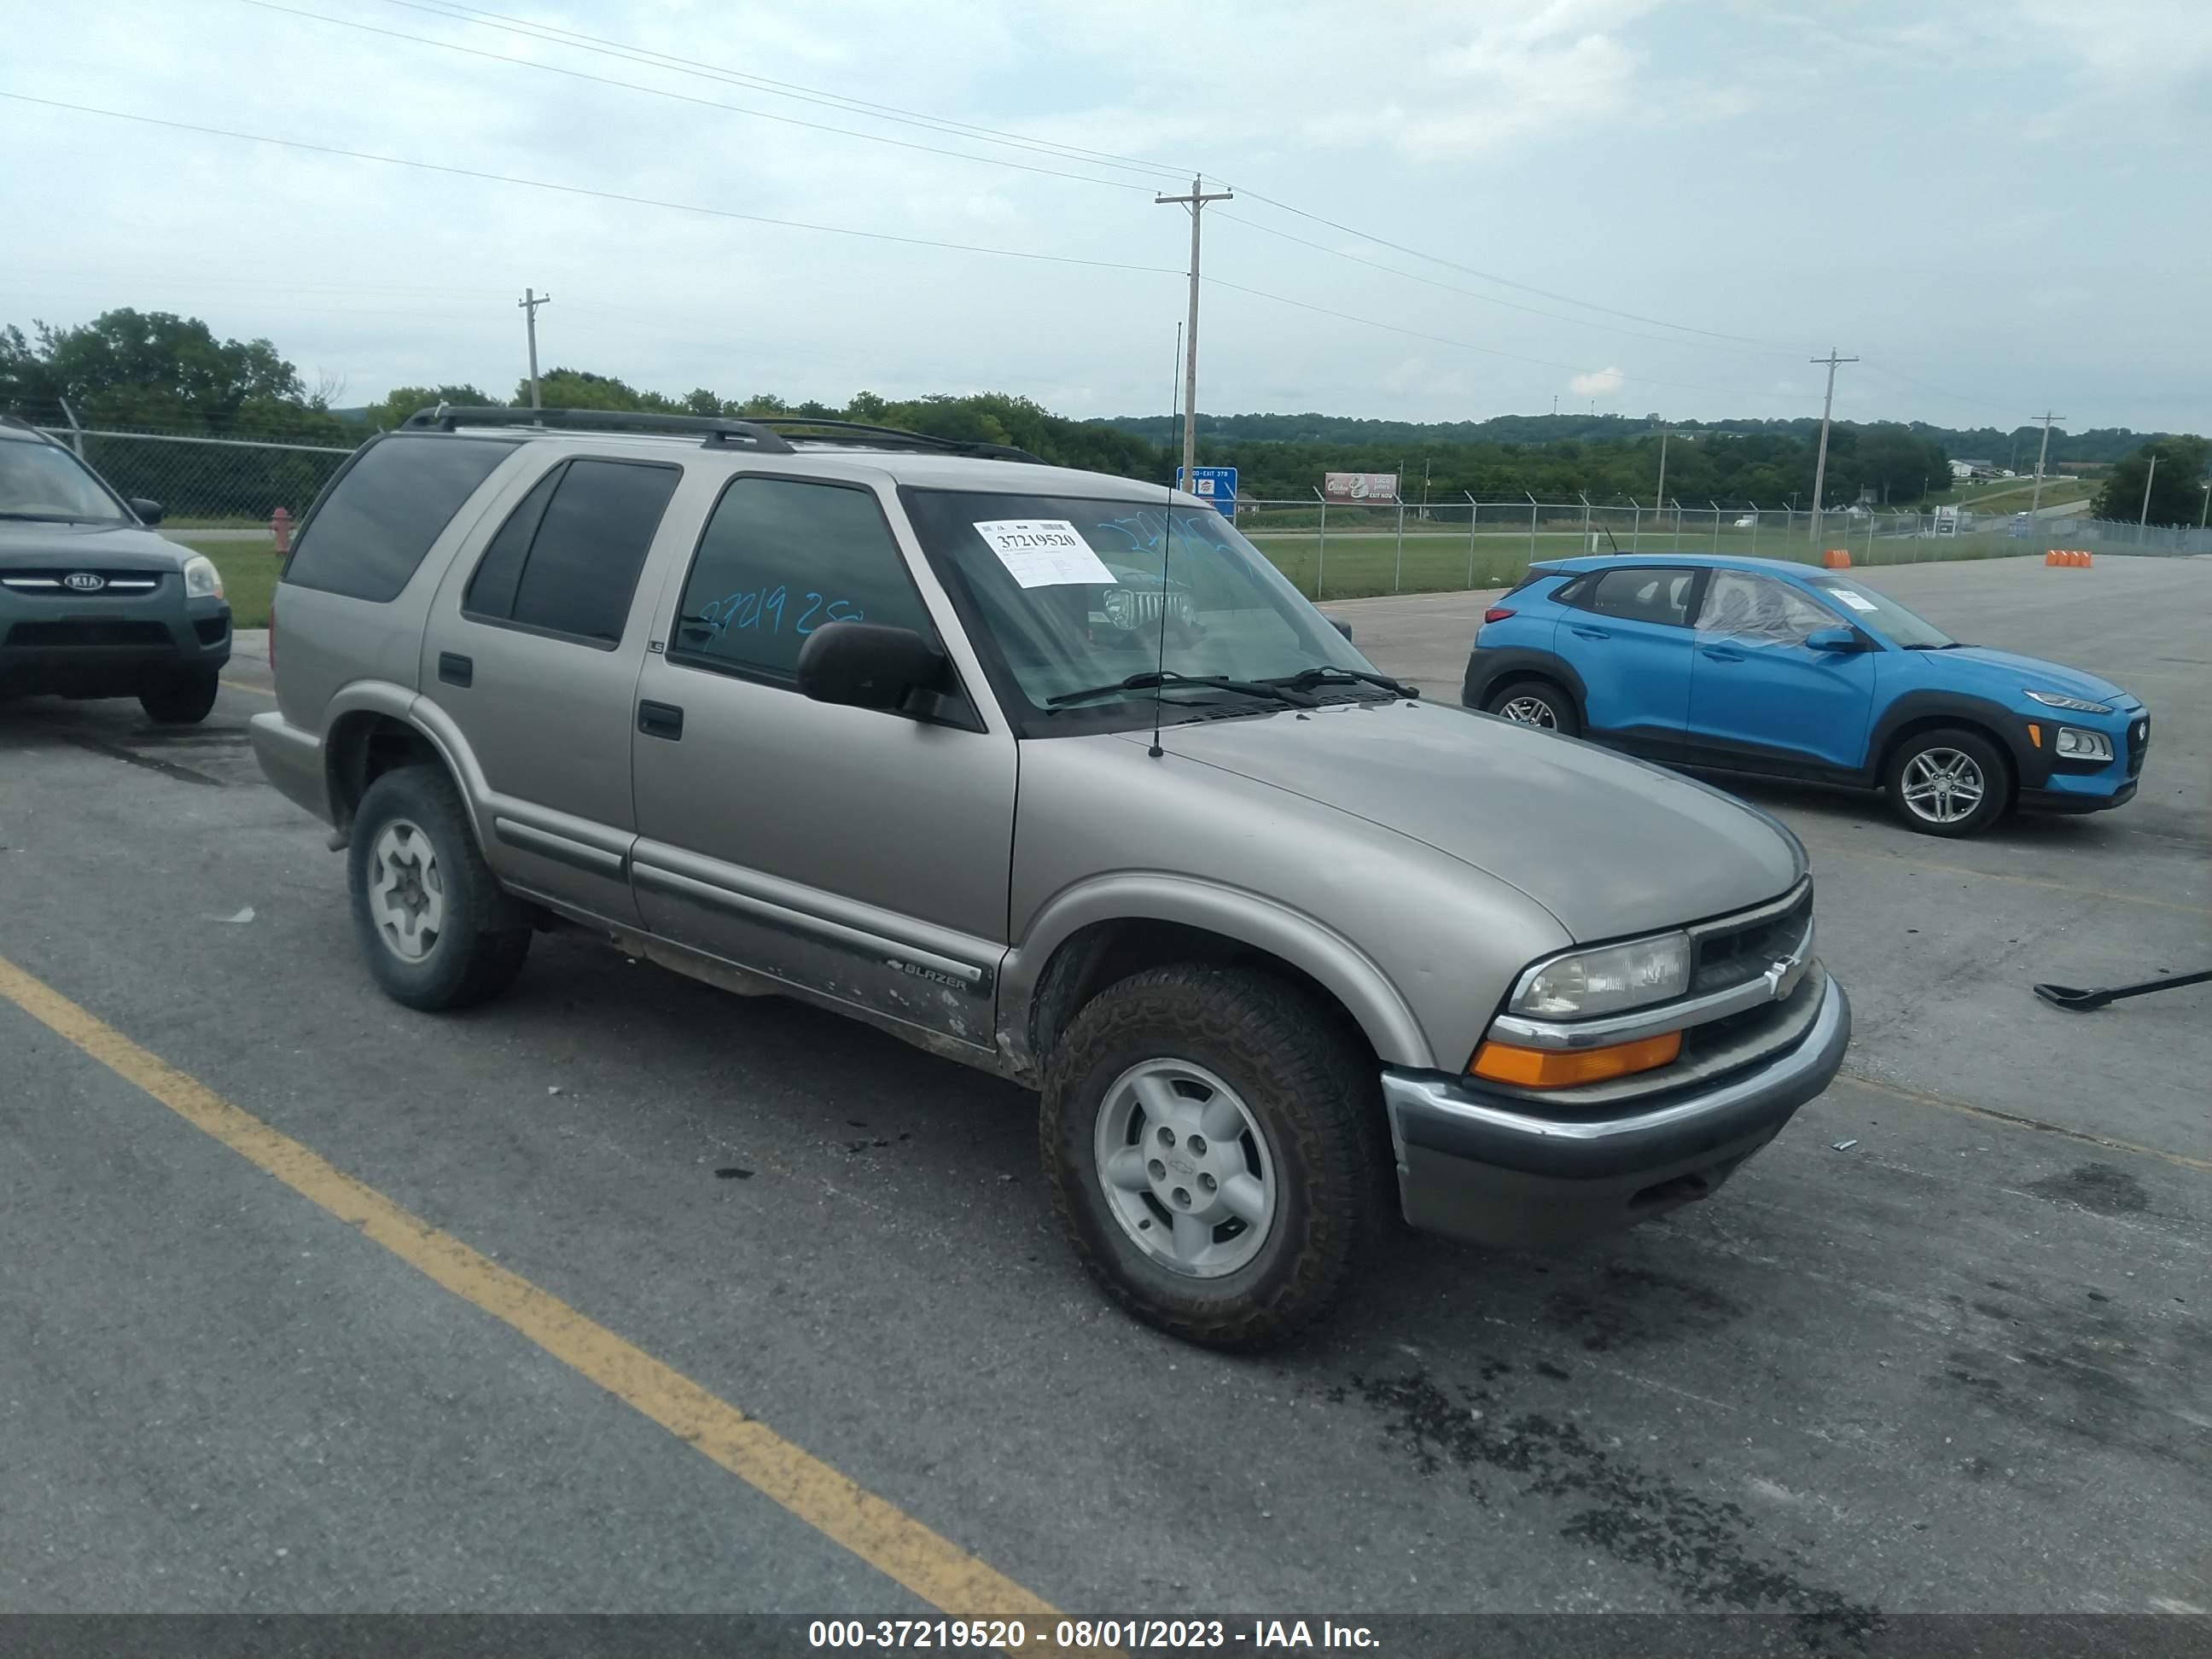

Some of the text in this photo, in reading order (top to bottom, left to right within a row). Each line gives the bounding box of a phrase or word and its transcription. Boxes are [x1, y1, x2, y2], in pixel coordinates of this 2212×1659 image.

[996, 533, 1077, 549] 37219520
[71, 576, 100, 587] KIA
[905, 963, 968, 991] BLAZER
